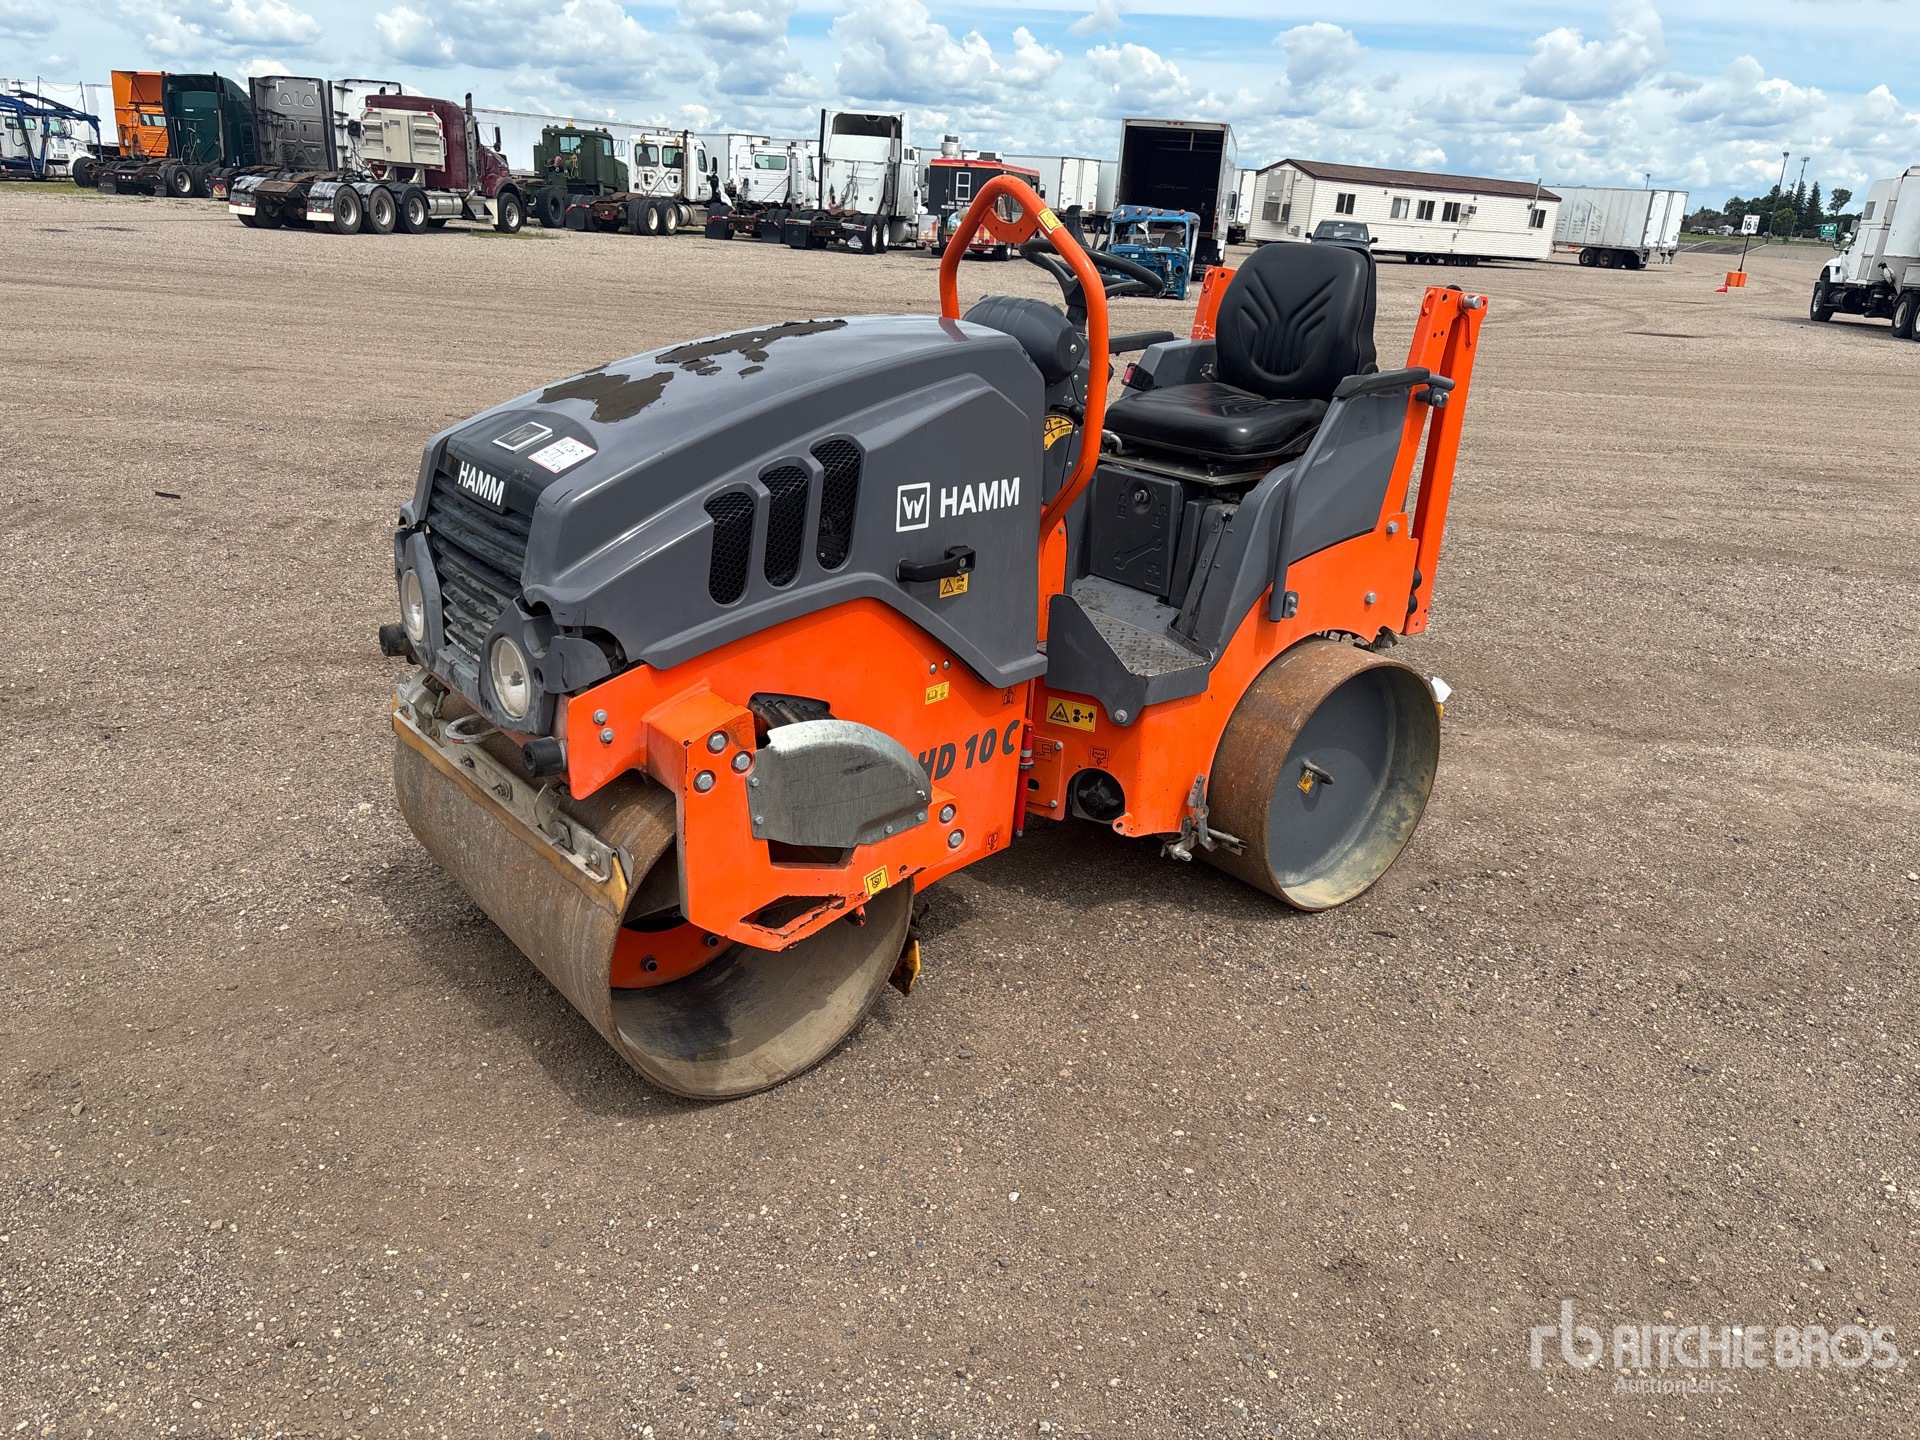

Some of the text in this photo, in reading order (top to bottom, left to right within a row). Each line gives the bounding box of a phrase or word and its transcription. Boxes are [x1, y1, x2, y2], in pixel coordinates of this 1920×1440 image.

[457, 460, 505, 506] HAMM
[939, 476, 1020, 519] HAMM
[918, 719, 1020, 781] HD 10 C
